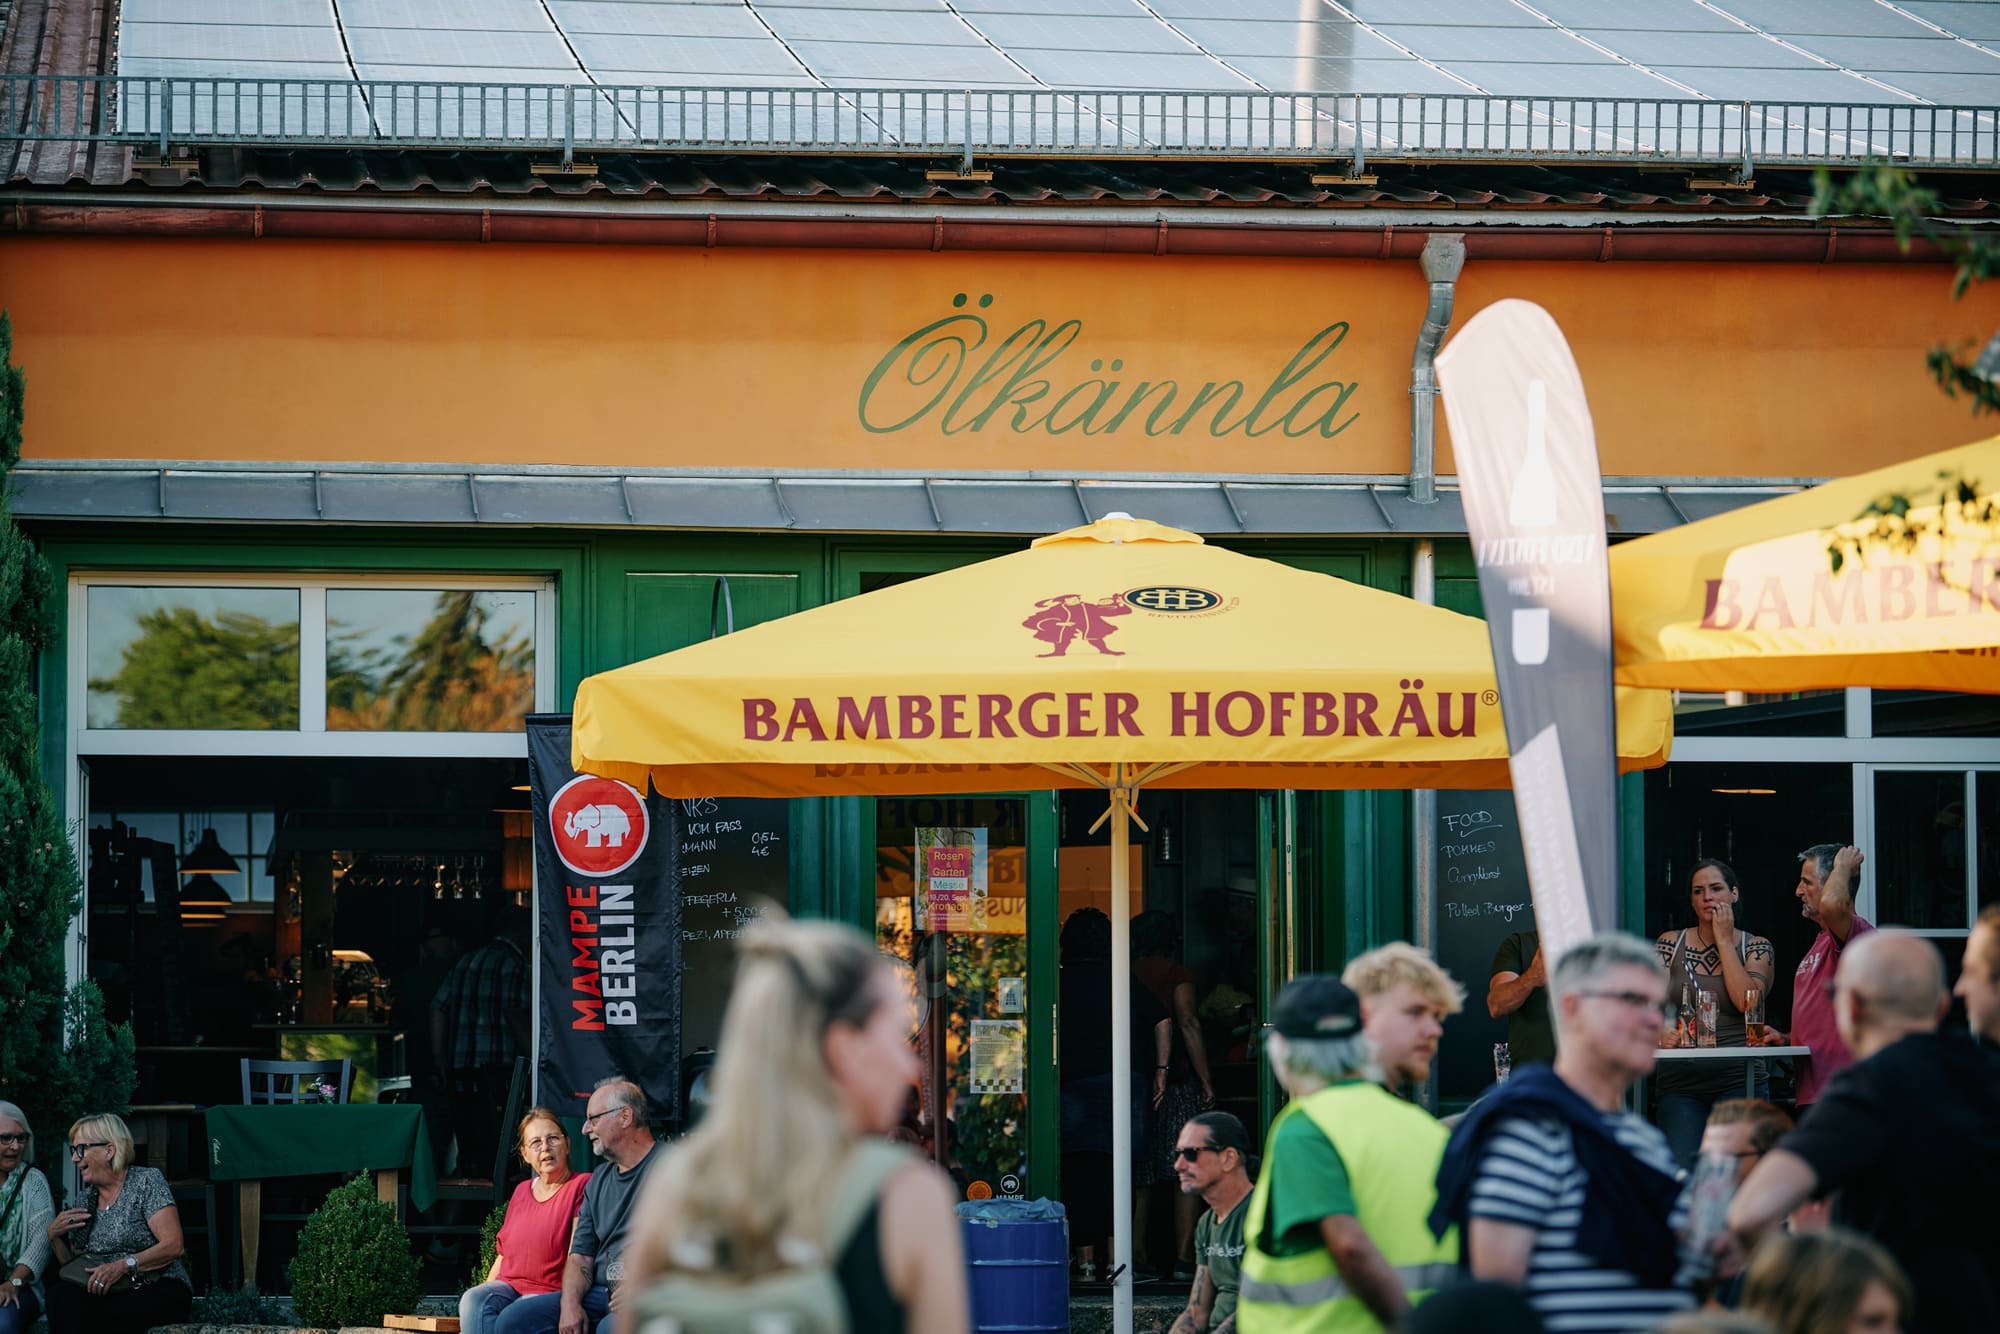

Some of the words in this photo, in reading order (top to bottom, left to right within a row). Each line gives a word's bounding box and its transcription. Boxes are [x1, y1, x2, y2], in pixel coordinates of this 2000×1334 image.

[858, 292, 1361, 439] Ölkännla
[742, 692, 1145, 742] BAMBERGER
[1442, 811, 1492, 832] FOOD
[932, 868, 965, 877] Garten
[934, 851, 964, 861] Rosen
[1483, 902, 1524, 922] Burger
[566, 885, 605, 1032] MAMPE
[600, 884, 638, 1026] BERLIN
